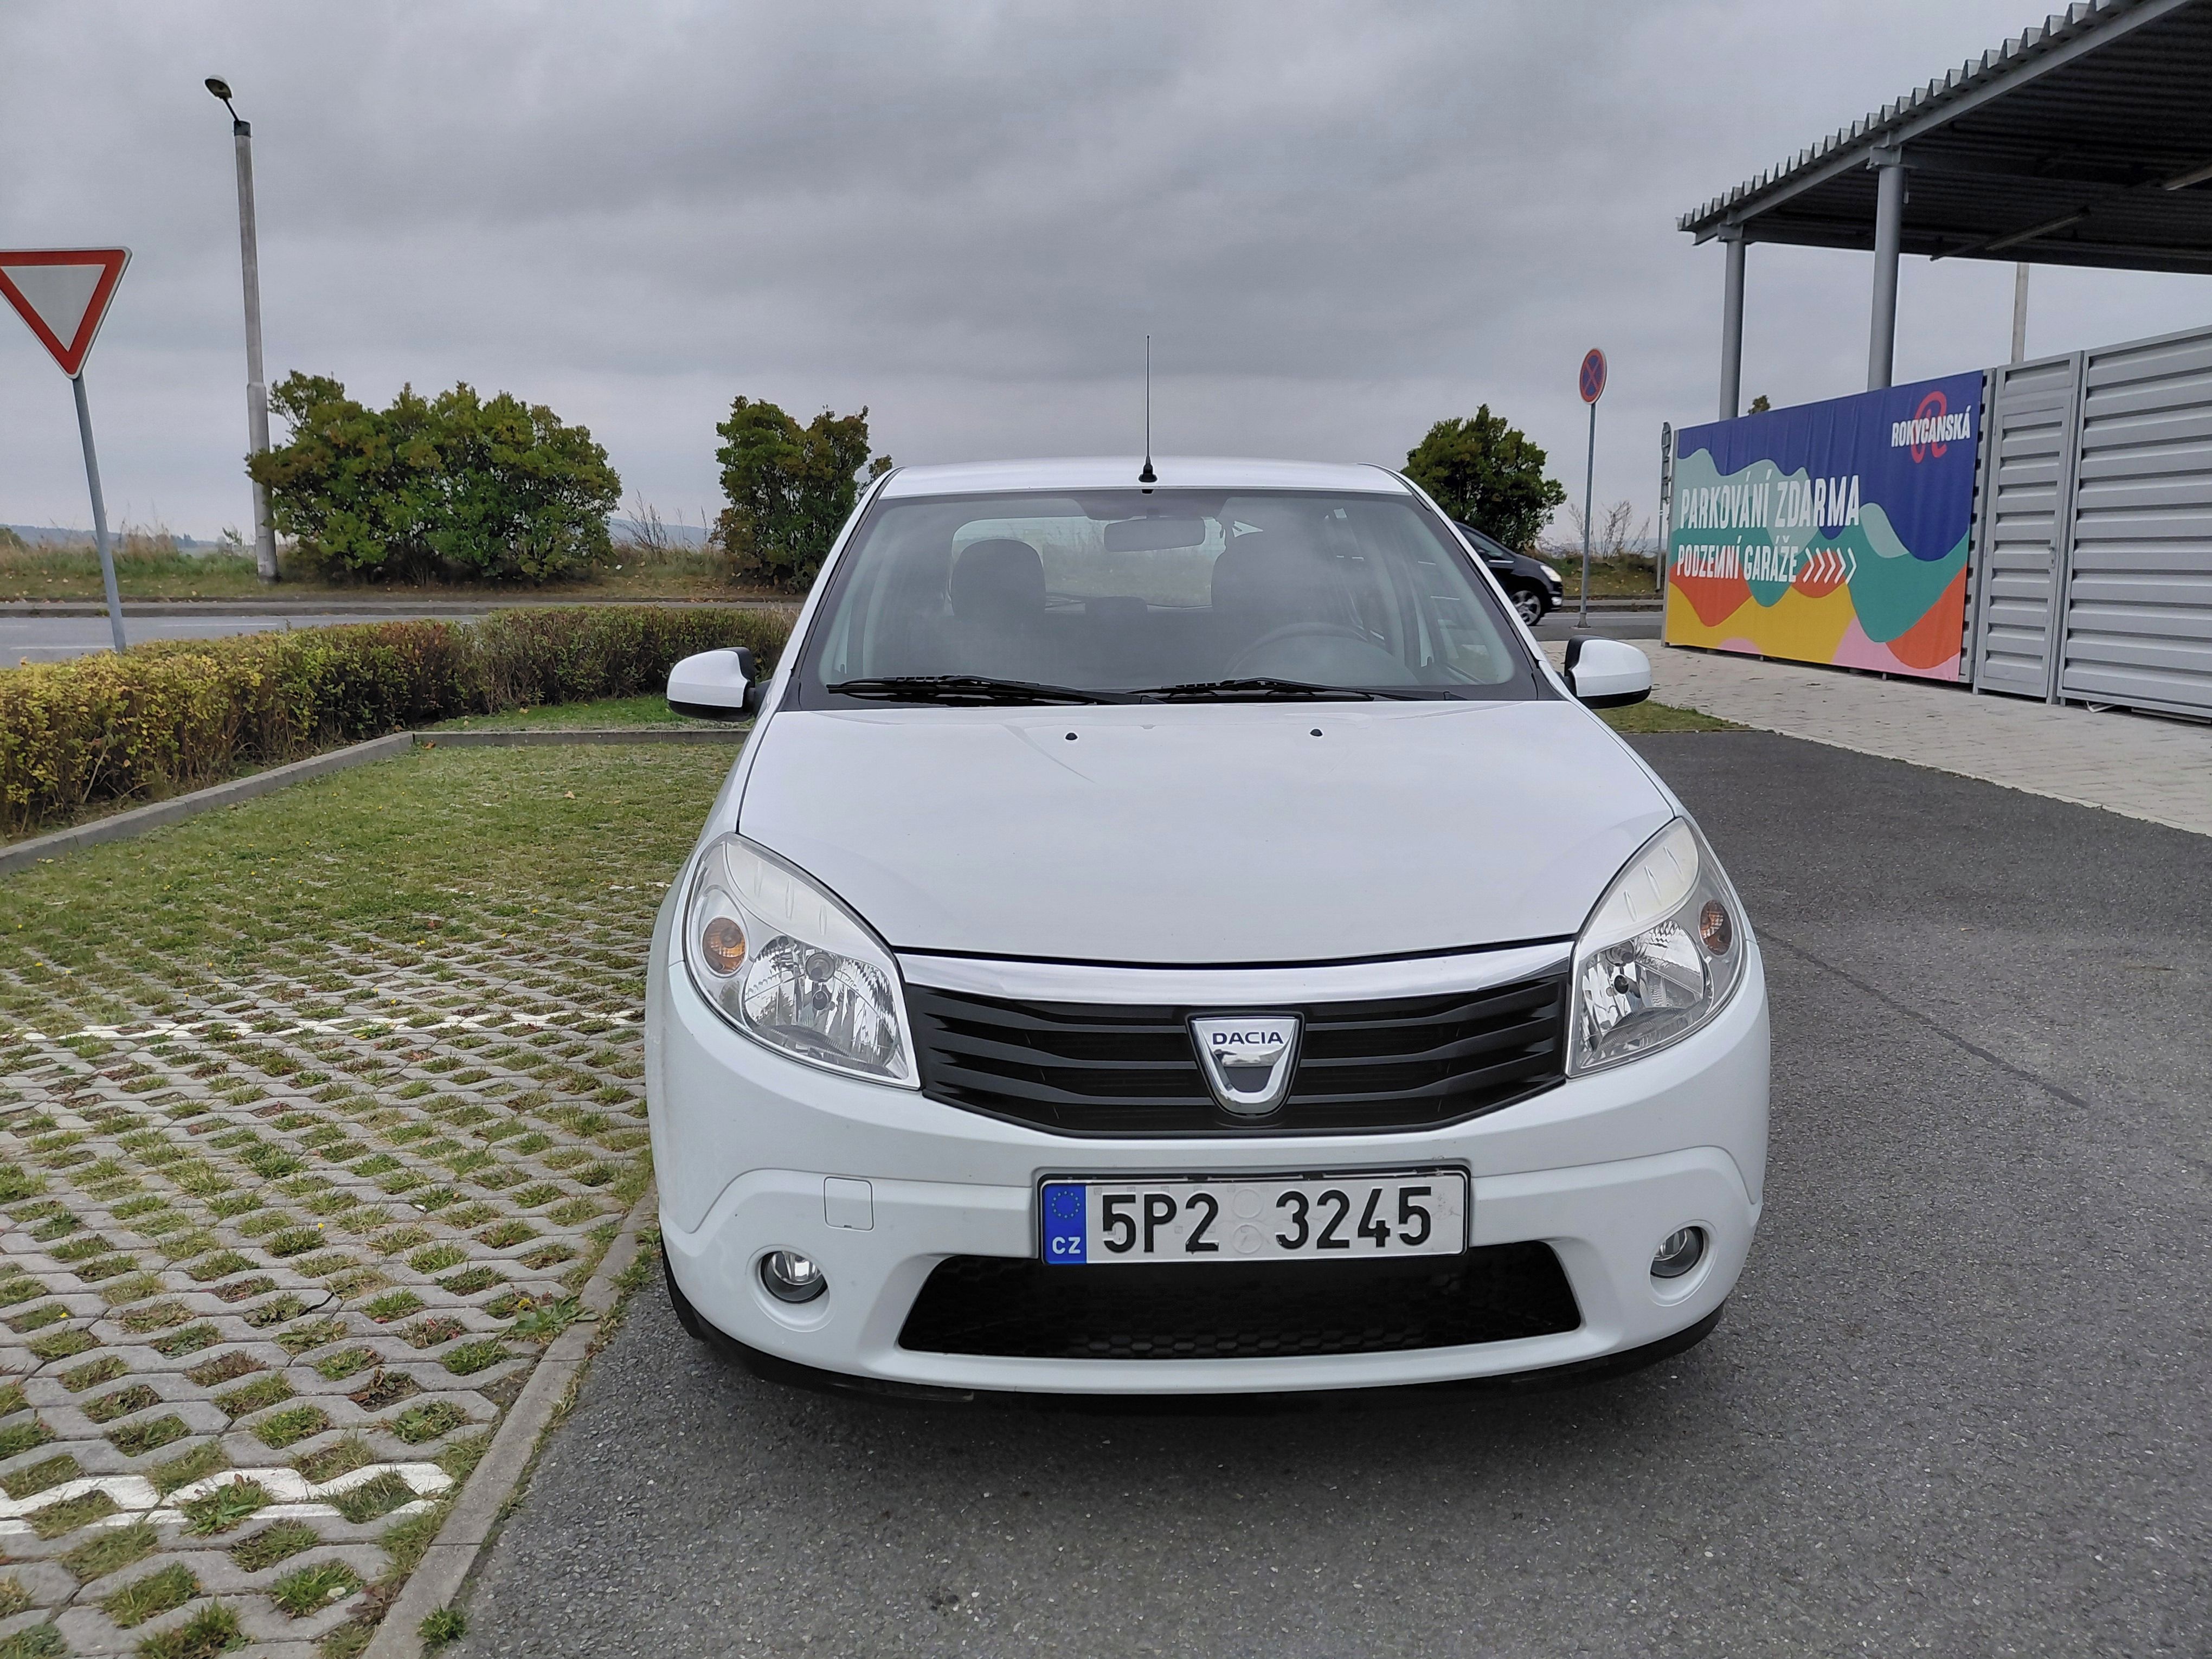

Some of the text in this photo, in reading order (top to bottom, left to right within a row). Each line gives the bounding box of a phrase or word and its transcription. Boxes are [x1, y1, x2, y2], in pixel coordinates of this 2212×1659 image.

[1891, 405, 1972, 448] ROKYCANSKÁ
[1680, 468, 1860, 529] PARKOVÁNÍ ZDARMA
[1676, 535, 1799, 583] PODZEMNÍ GARÁŽE
[1212, 1032, 1284, 1045] DACIA
[1103, 1186, 1432, 1254] 5P2 3245
[1052, 1237, 1081, 1254] CZ
